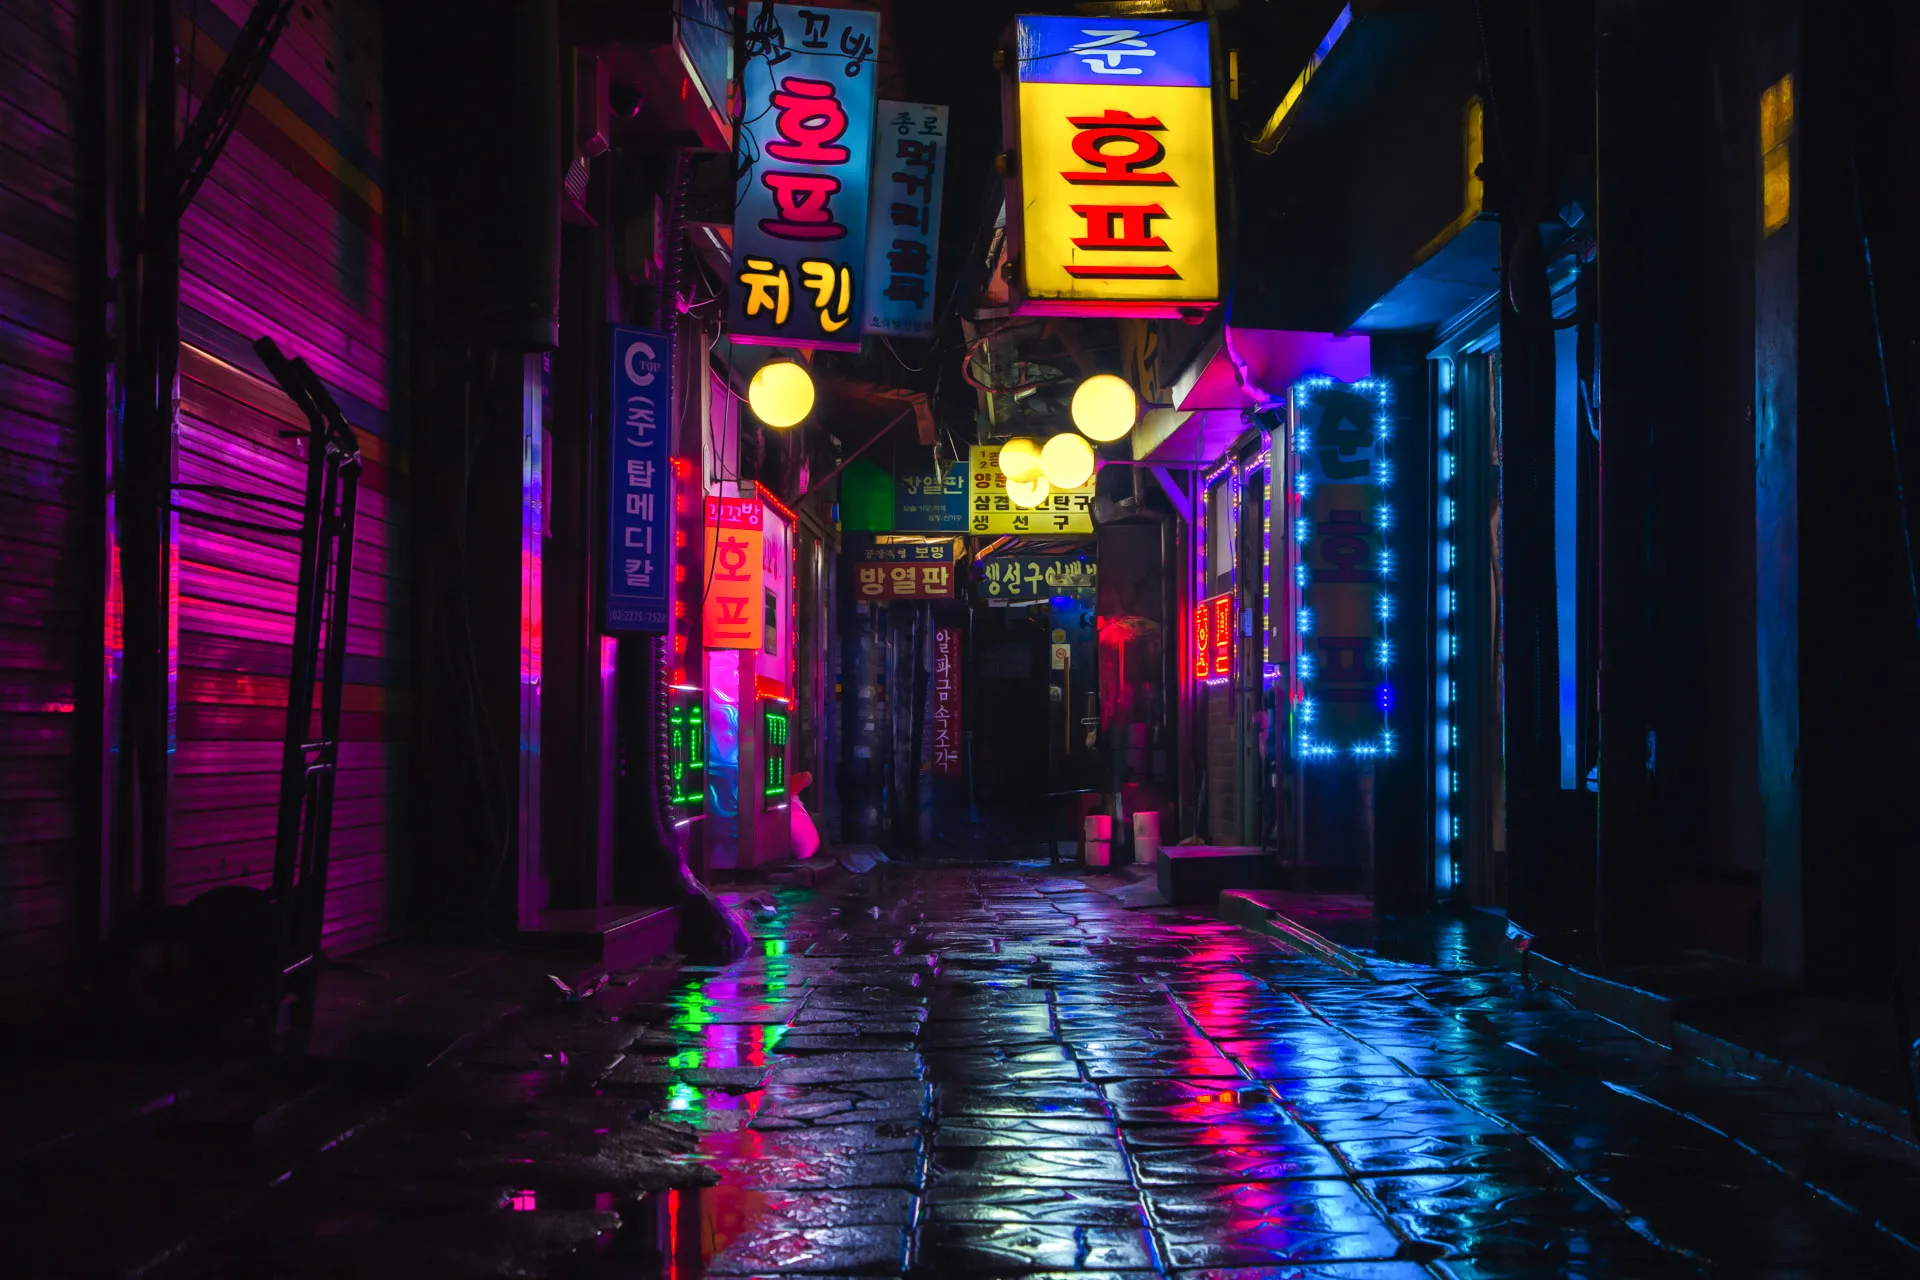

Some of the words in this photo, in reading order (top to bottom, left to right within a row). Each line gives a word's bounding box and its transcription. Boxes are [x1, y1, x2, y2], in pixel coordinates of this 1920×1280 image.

[1069, 29, 1156, 75] 준
[758, 76, 850, 242] 호프
[891, 111, 943, 136] 종로
[883, 138, 937, 311] 먹거리골목
[1060, 109, 1184, 281] 호프
[738, 254, 855, 333] 치킨
[626, 395, 656, 448] (주)
[624, 459, 656, 588] 탑메디칼
[708, 502, 761, 525] 꼬꼬방
[915, 546, 944, 559] 보명
[714, 535, 752, 639] 호프
[860, 566, 949, 596] 방열판
[1313, 509, 1375, 702] 호프
[934, 629, 952, 774] 알파금속조각
